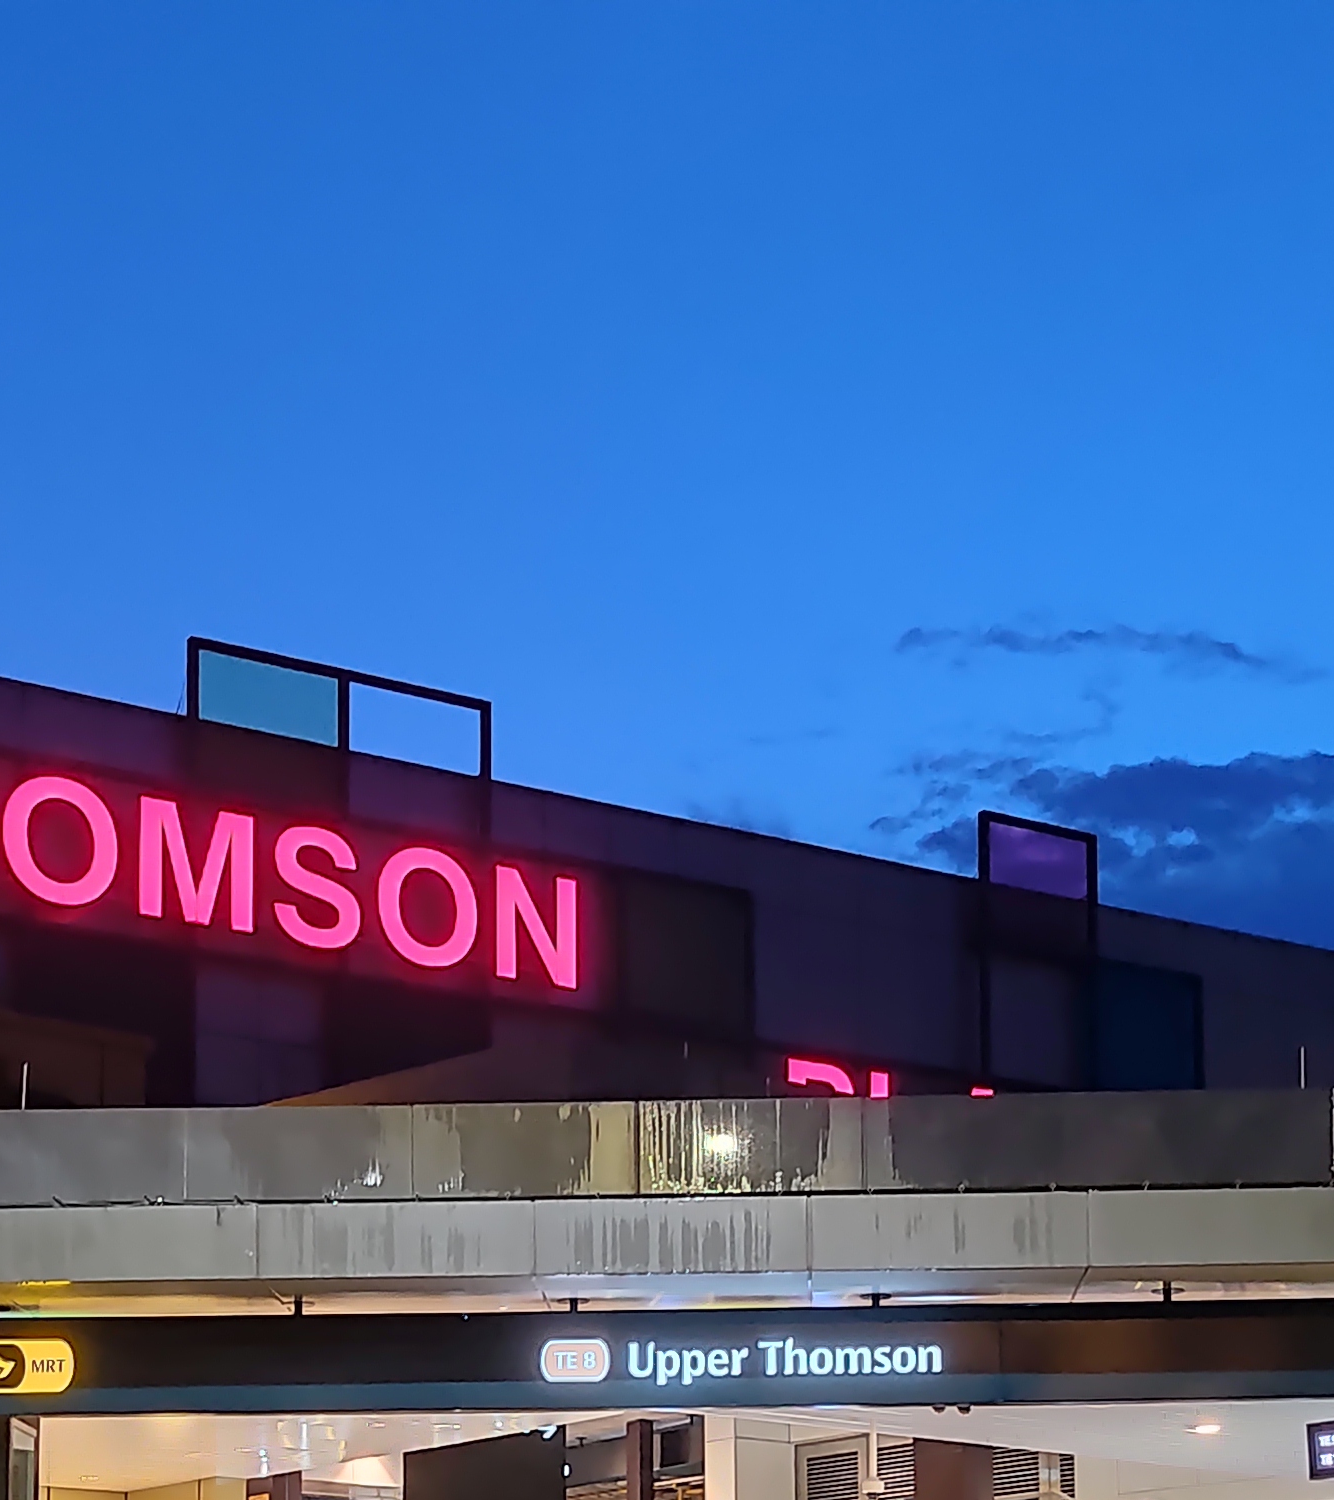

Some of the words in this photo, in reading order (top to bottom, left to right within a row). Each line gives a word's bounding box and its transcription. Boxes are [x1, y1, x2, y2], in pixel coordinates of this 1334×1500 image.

[31, 1359, 66, 1373] MRT
[553, 1351, 578, 1370] TE
[583, 1351, 596, 1370] 8
[627, 1340, 748, 1385] Upper
[757, 1337, 943, 1375] Thomson
